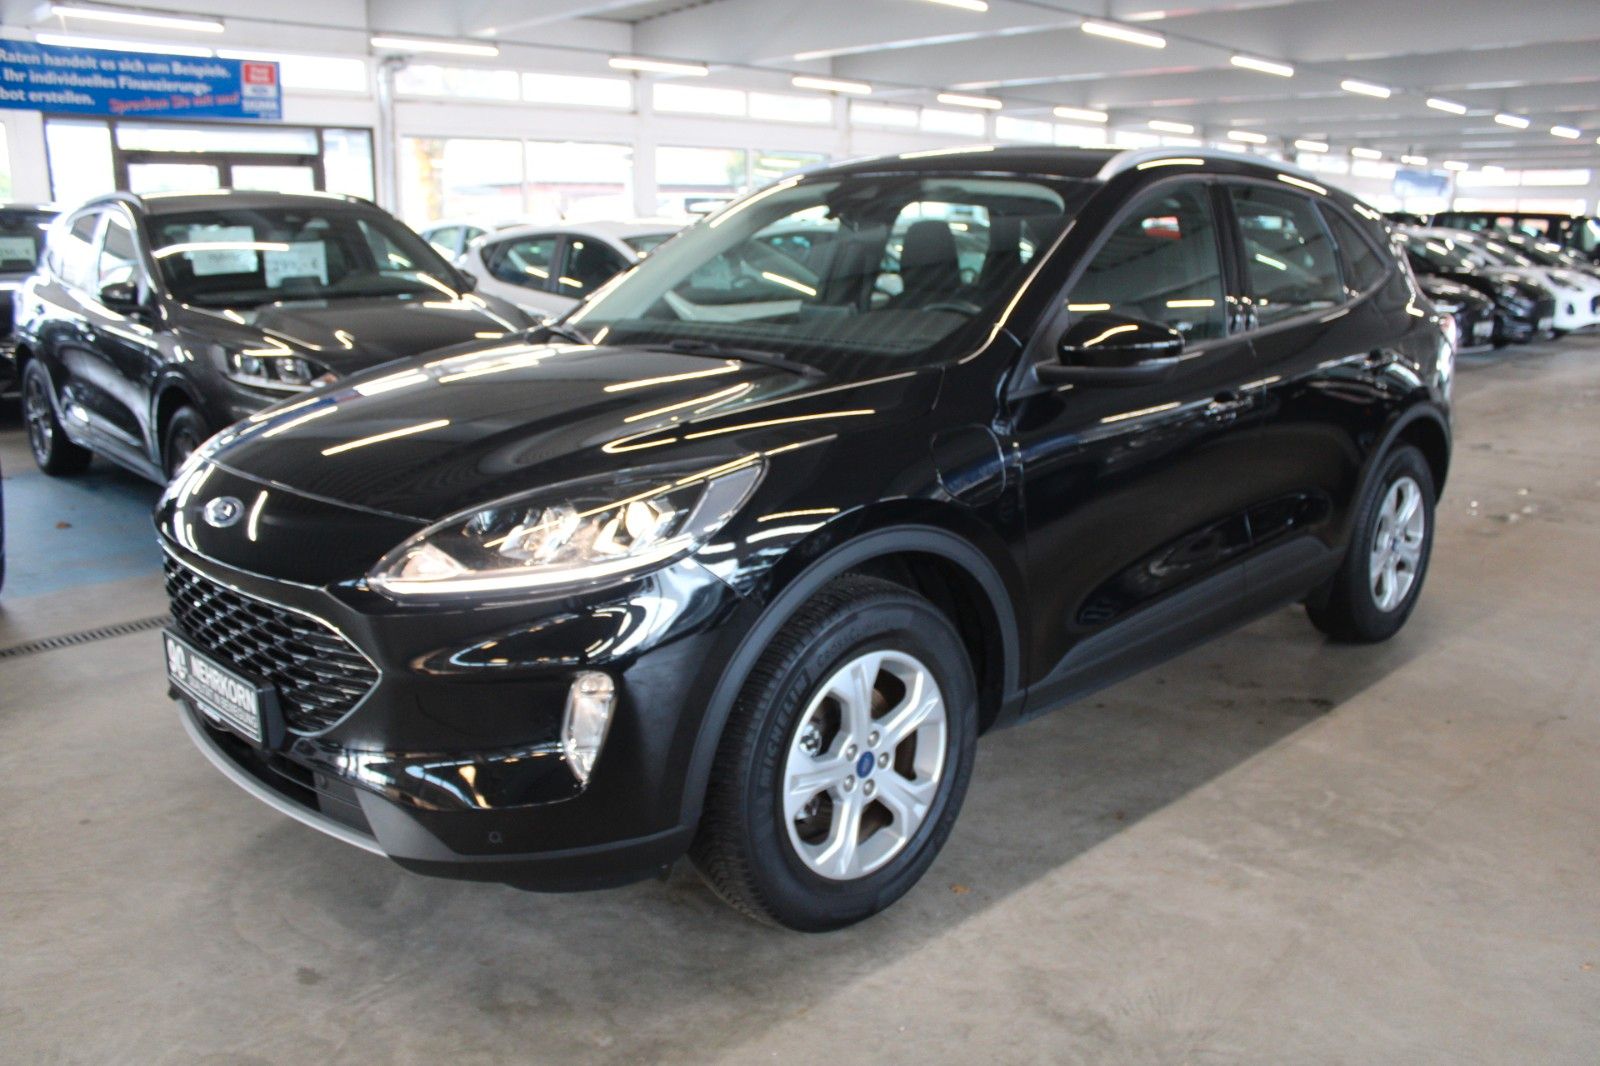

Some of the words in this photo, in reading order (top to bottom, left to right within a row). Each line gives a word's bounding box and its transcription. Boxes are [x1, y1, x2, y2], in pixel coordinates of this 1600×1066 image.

[43, 52, 97, 69] handelt
[100, 59, 117, 71] es
[118, 59, 145, 73] sich
[147, 63, 170, 74] um
[4, 67, 26, 82] Ihr
[29, 69, 117, 89] individuelles
[28, 89, 96, 106] erstellen.
